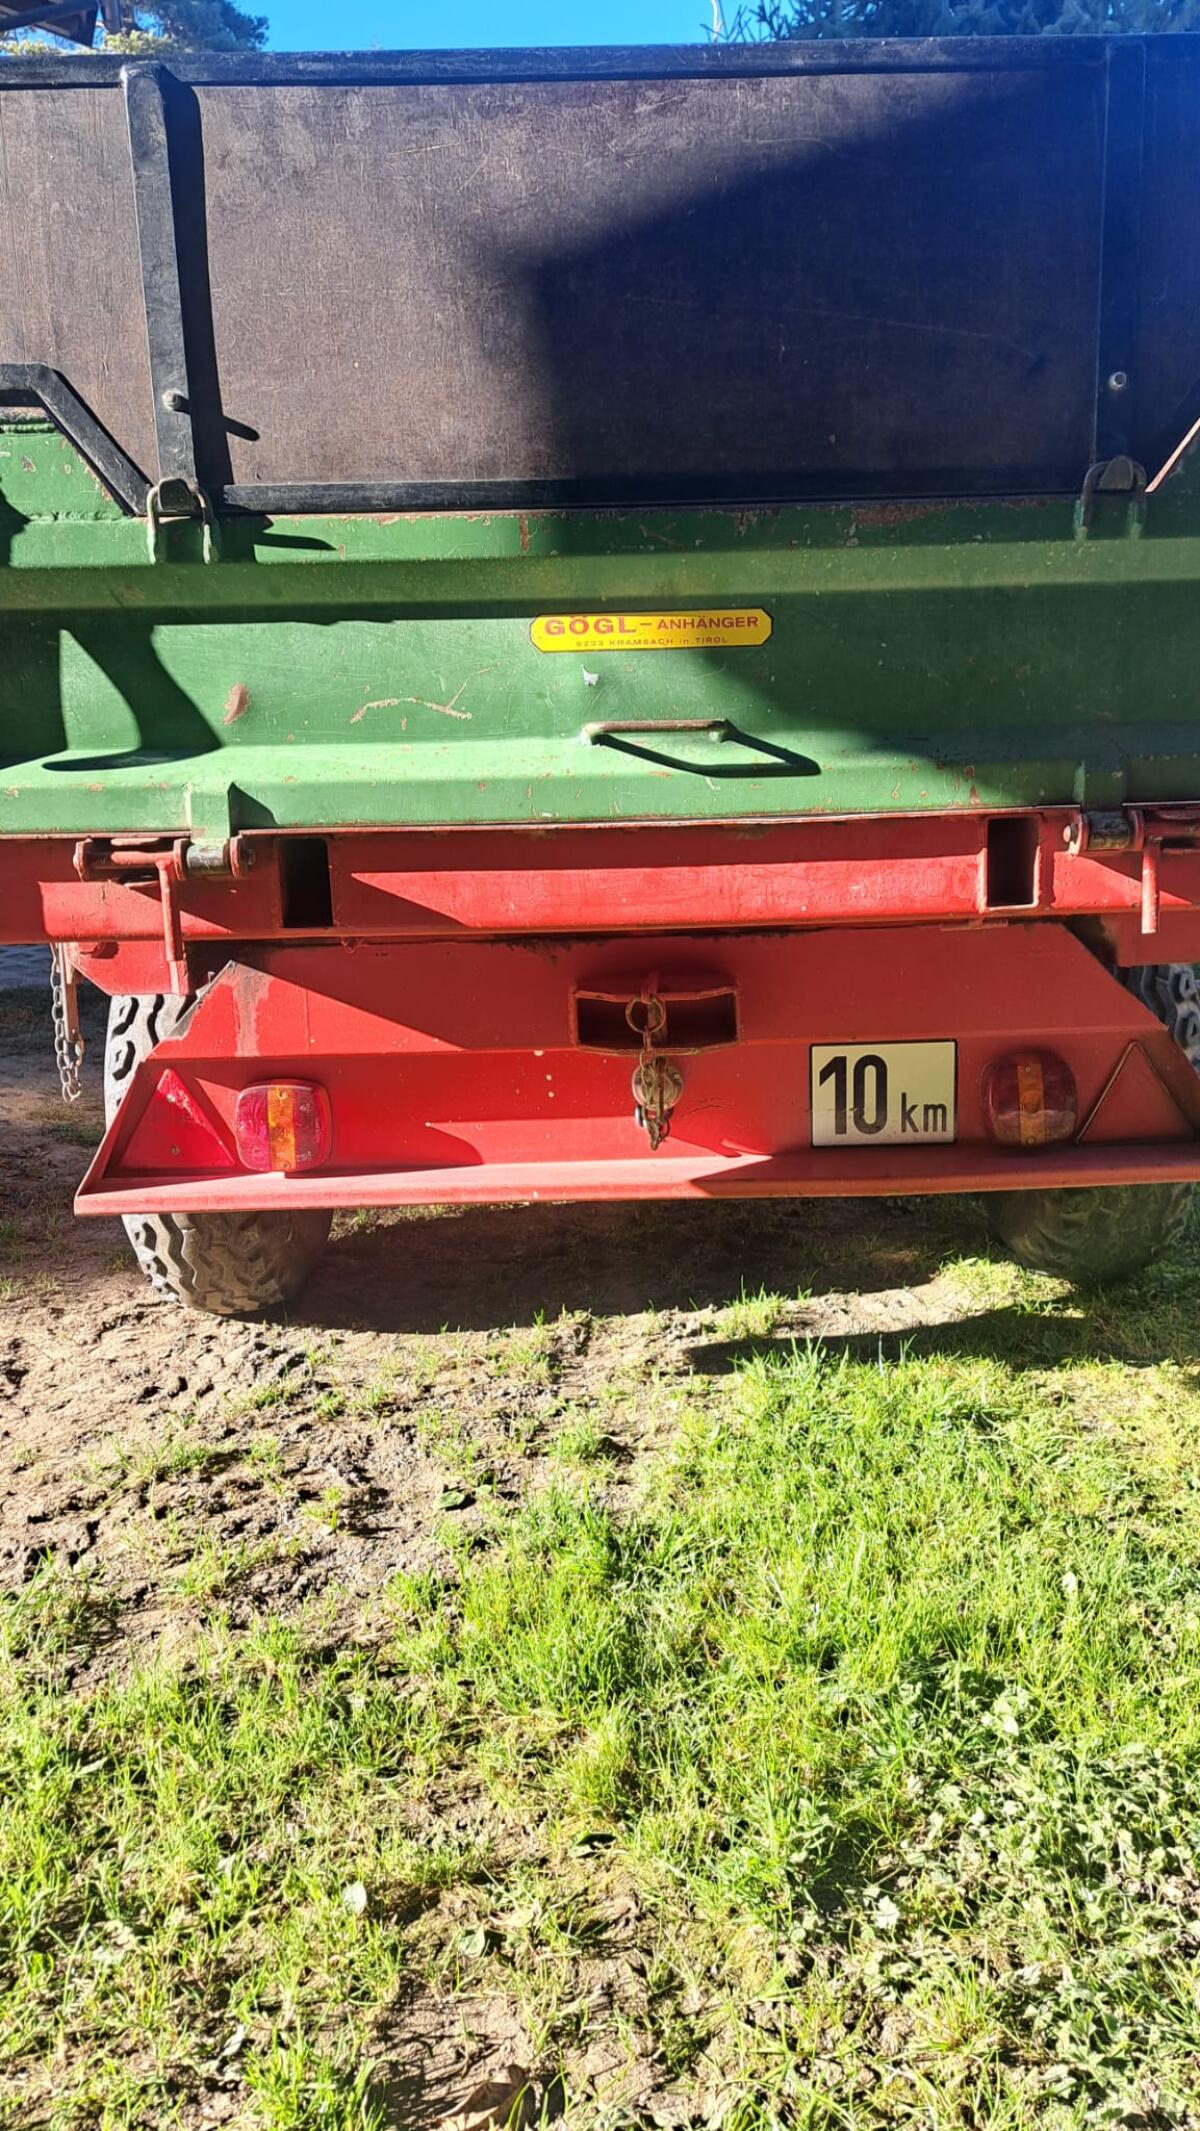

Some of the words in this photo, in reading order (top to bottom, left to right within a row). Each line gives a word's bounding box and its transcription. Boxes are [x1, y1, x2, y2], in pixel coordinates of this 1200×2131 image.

[609, 638, 673, 646] KRAMSACH
[695, 636, 728, 644] TIROL
[819, 1054, 888, 1135] 10
[901, 1092, 947, 1133] km
